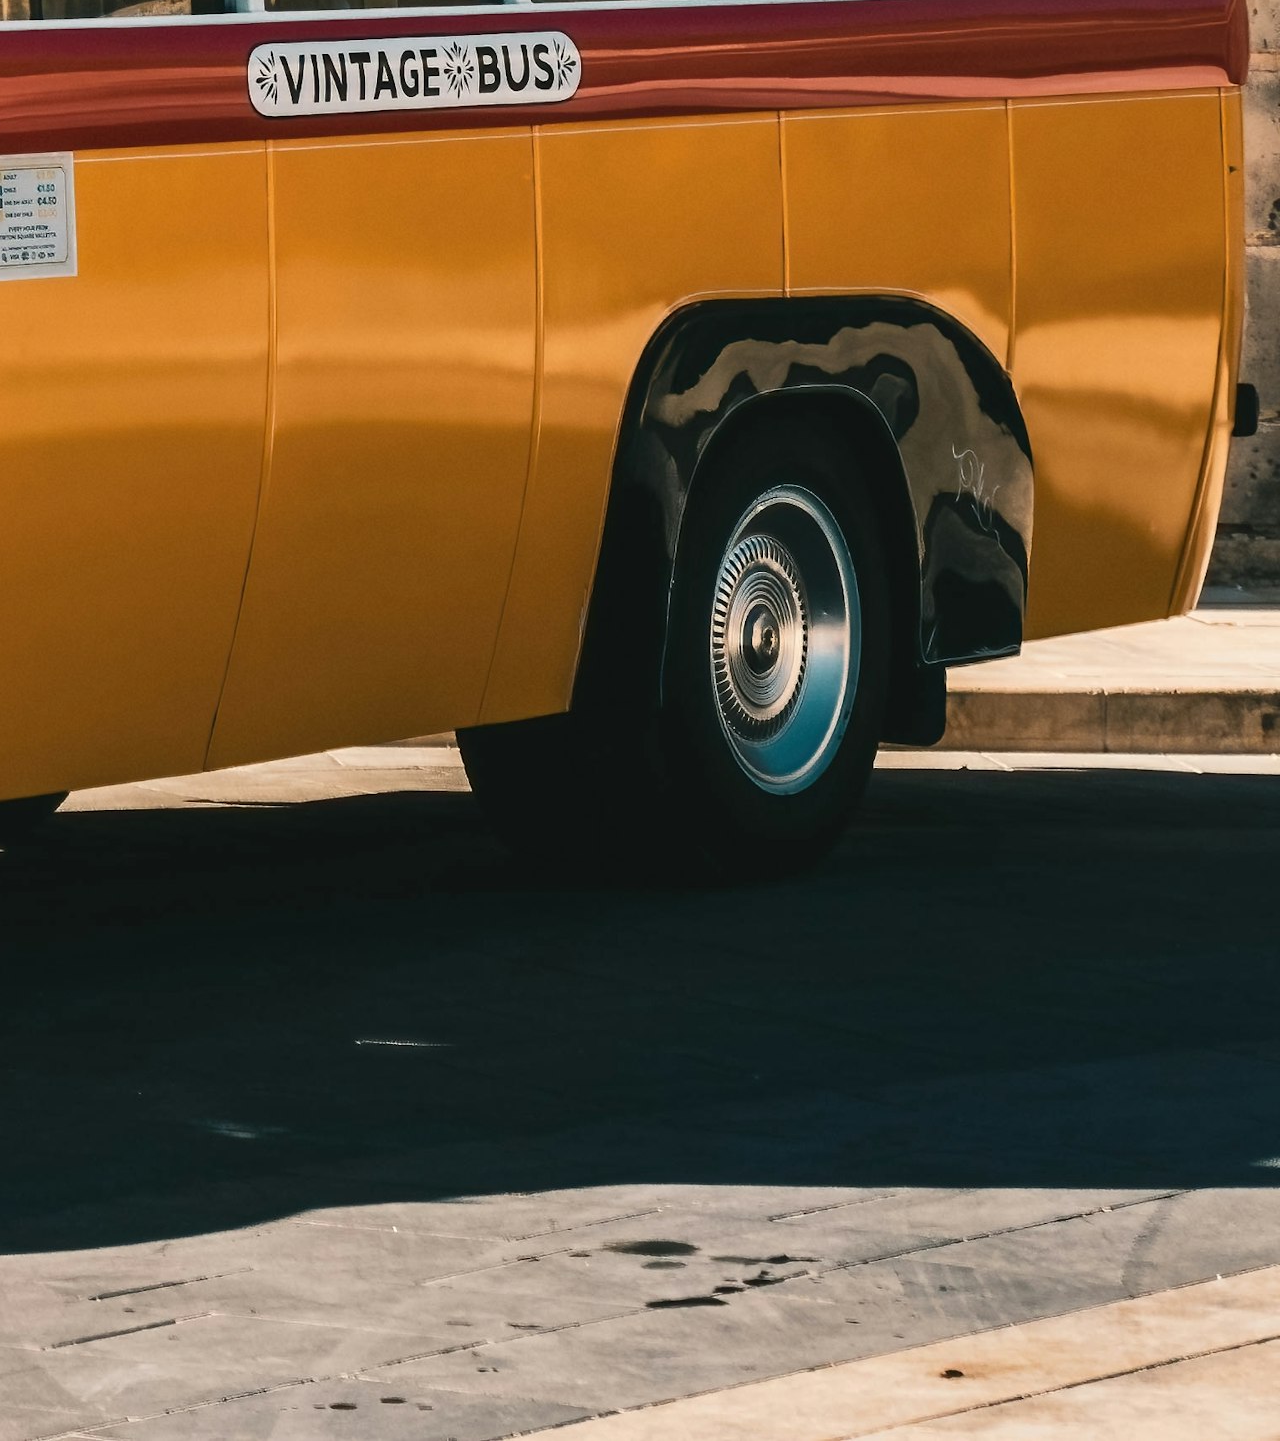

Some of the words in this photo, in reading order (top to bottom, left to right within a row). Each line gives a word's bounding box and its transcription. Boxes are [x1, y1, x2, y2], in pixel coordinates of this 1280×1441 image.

[279, 48, 440, 105] VINTAGE
[474, 44, 556, 94] BUS
[37, 196, 57, 206] €4.50
